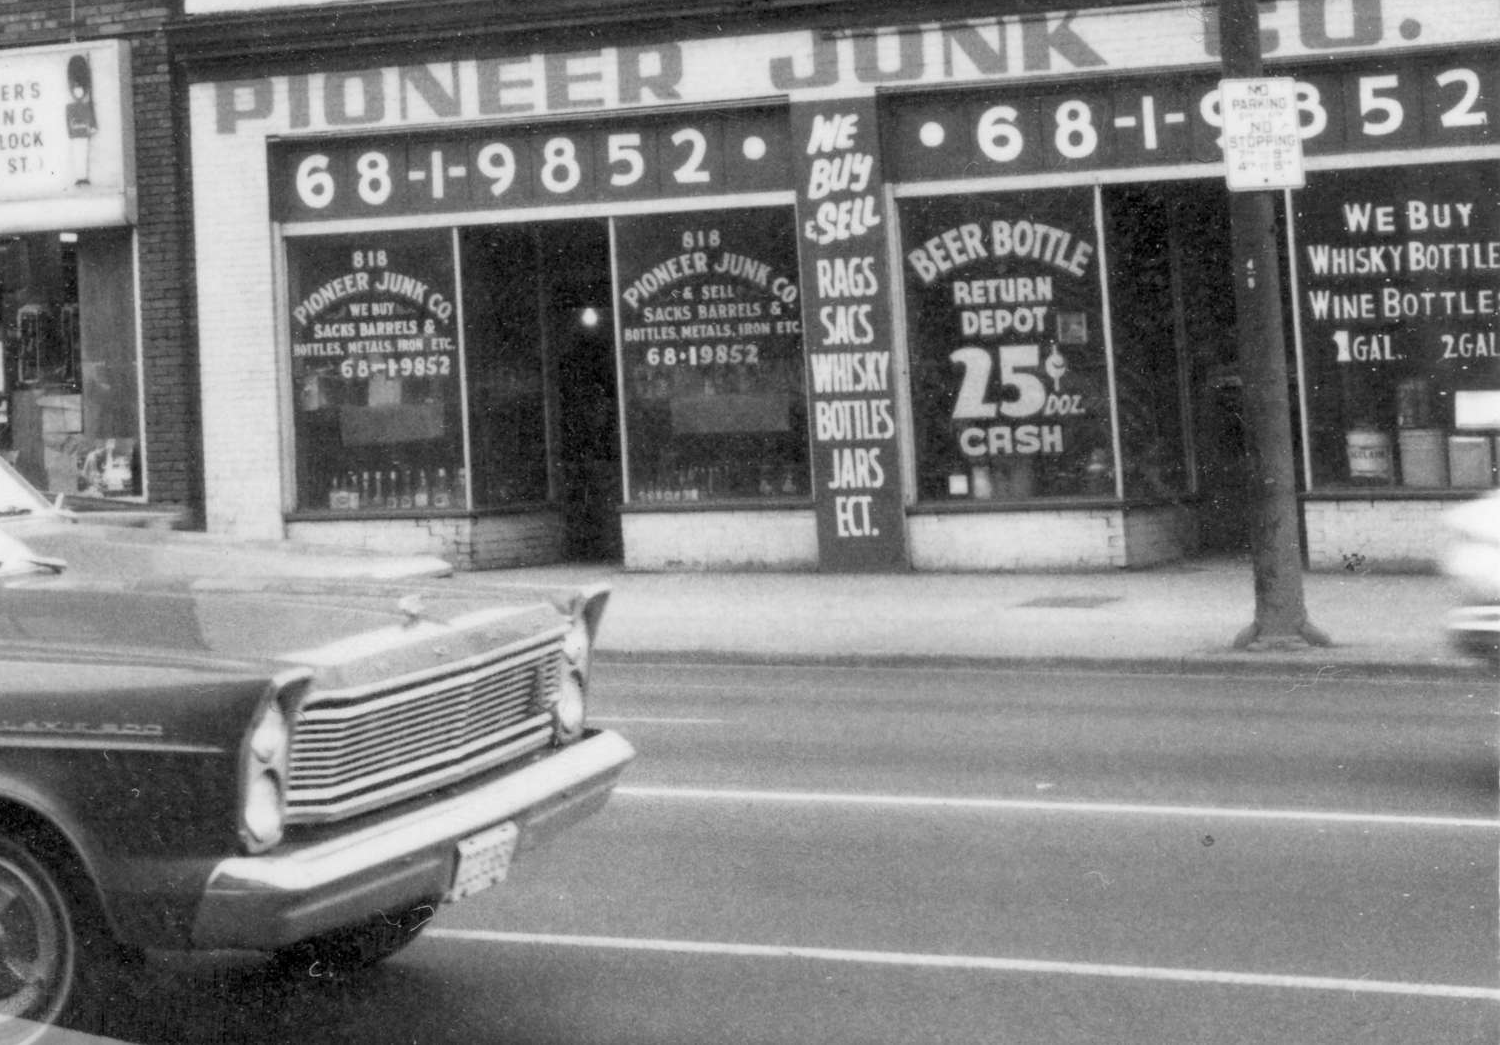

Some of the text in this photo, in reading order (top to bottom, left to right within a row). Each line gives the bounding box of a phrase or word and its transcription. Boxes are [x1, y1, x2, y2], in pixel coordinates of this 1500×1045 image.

[214, 41, 684, 135] PIONEER
[769, 11, 1109, 91] JUNK
[1231, 97, 1287, 111] PARKING
[1247, 83, 1269, 97] NO
[806, 113, 860, 155] WE
[1228, 134, 1296, 149] STOPPING
[1250, 121, 1273, 134] NO
[295, 128, 711, 210] 68-1-9852
[807, 152, 874, 200] BUY
[1343, 200, 1474, 233] WE BUY
[682, 229, 721, 248] 818
[907, 220, 1094, 283] BEER BOTTLE
[352, 249, 389, 269] 818
[1307, 244, 1404, 275] WHISKY
[622, 251, 709, 309] PIONEER
[713, 251, 772, 287] JUNK
[700, 284, 736, 300] SELL
[816, 256, 879, 298] RAGS
[952, 276, 1054, 305] RETURN
[292, 271, 370, 326] PIONEER
[374, 270, 430, 305] JUNK
[349, 302, 396, 317] WE BUY
[643, 300, 782, 324] SACKS BARRELS &
[1308, 286, 1500, 320] WINE BOTTLE
[313, 318, 436, 339] SACKS BARRELS &
[737, 322, 771, 335] IRON
[819, 304, 875, 346] SACS
[961, 306, 1048, 336] DEPOT
[397, 338, 424, 352] IRON
[810, 351, 890, 393] WHISKY
[814, 399, 895, 441] BOTTLES
[1043, 393, 1086, 416] DOZ.
[959, 424, 1064, 456] CASH
[827, 447, 885, 490] JARS
[835, 495, 881, 537] ECT.
